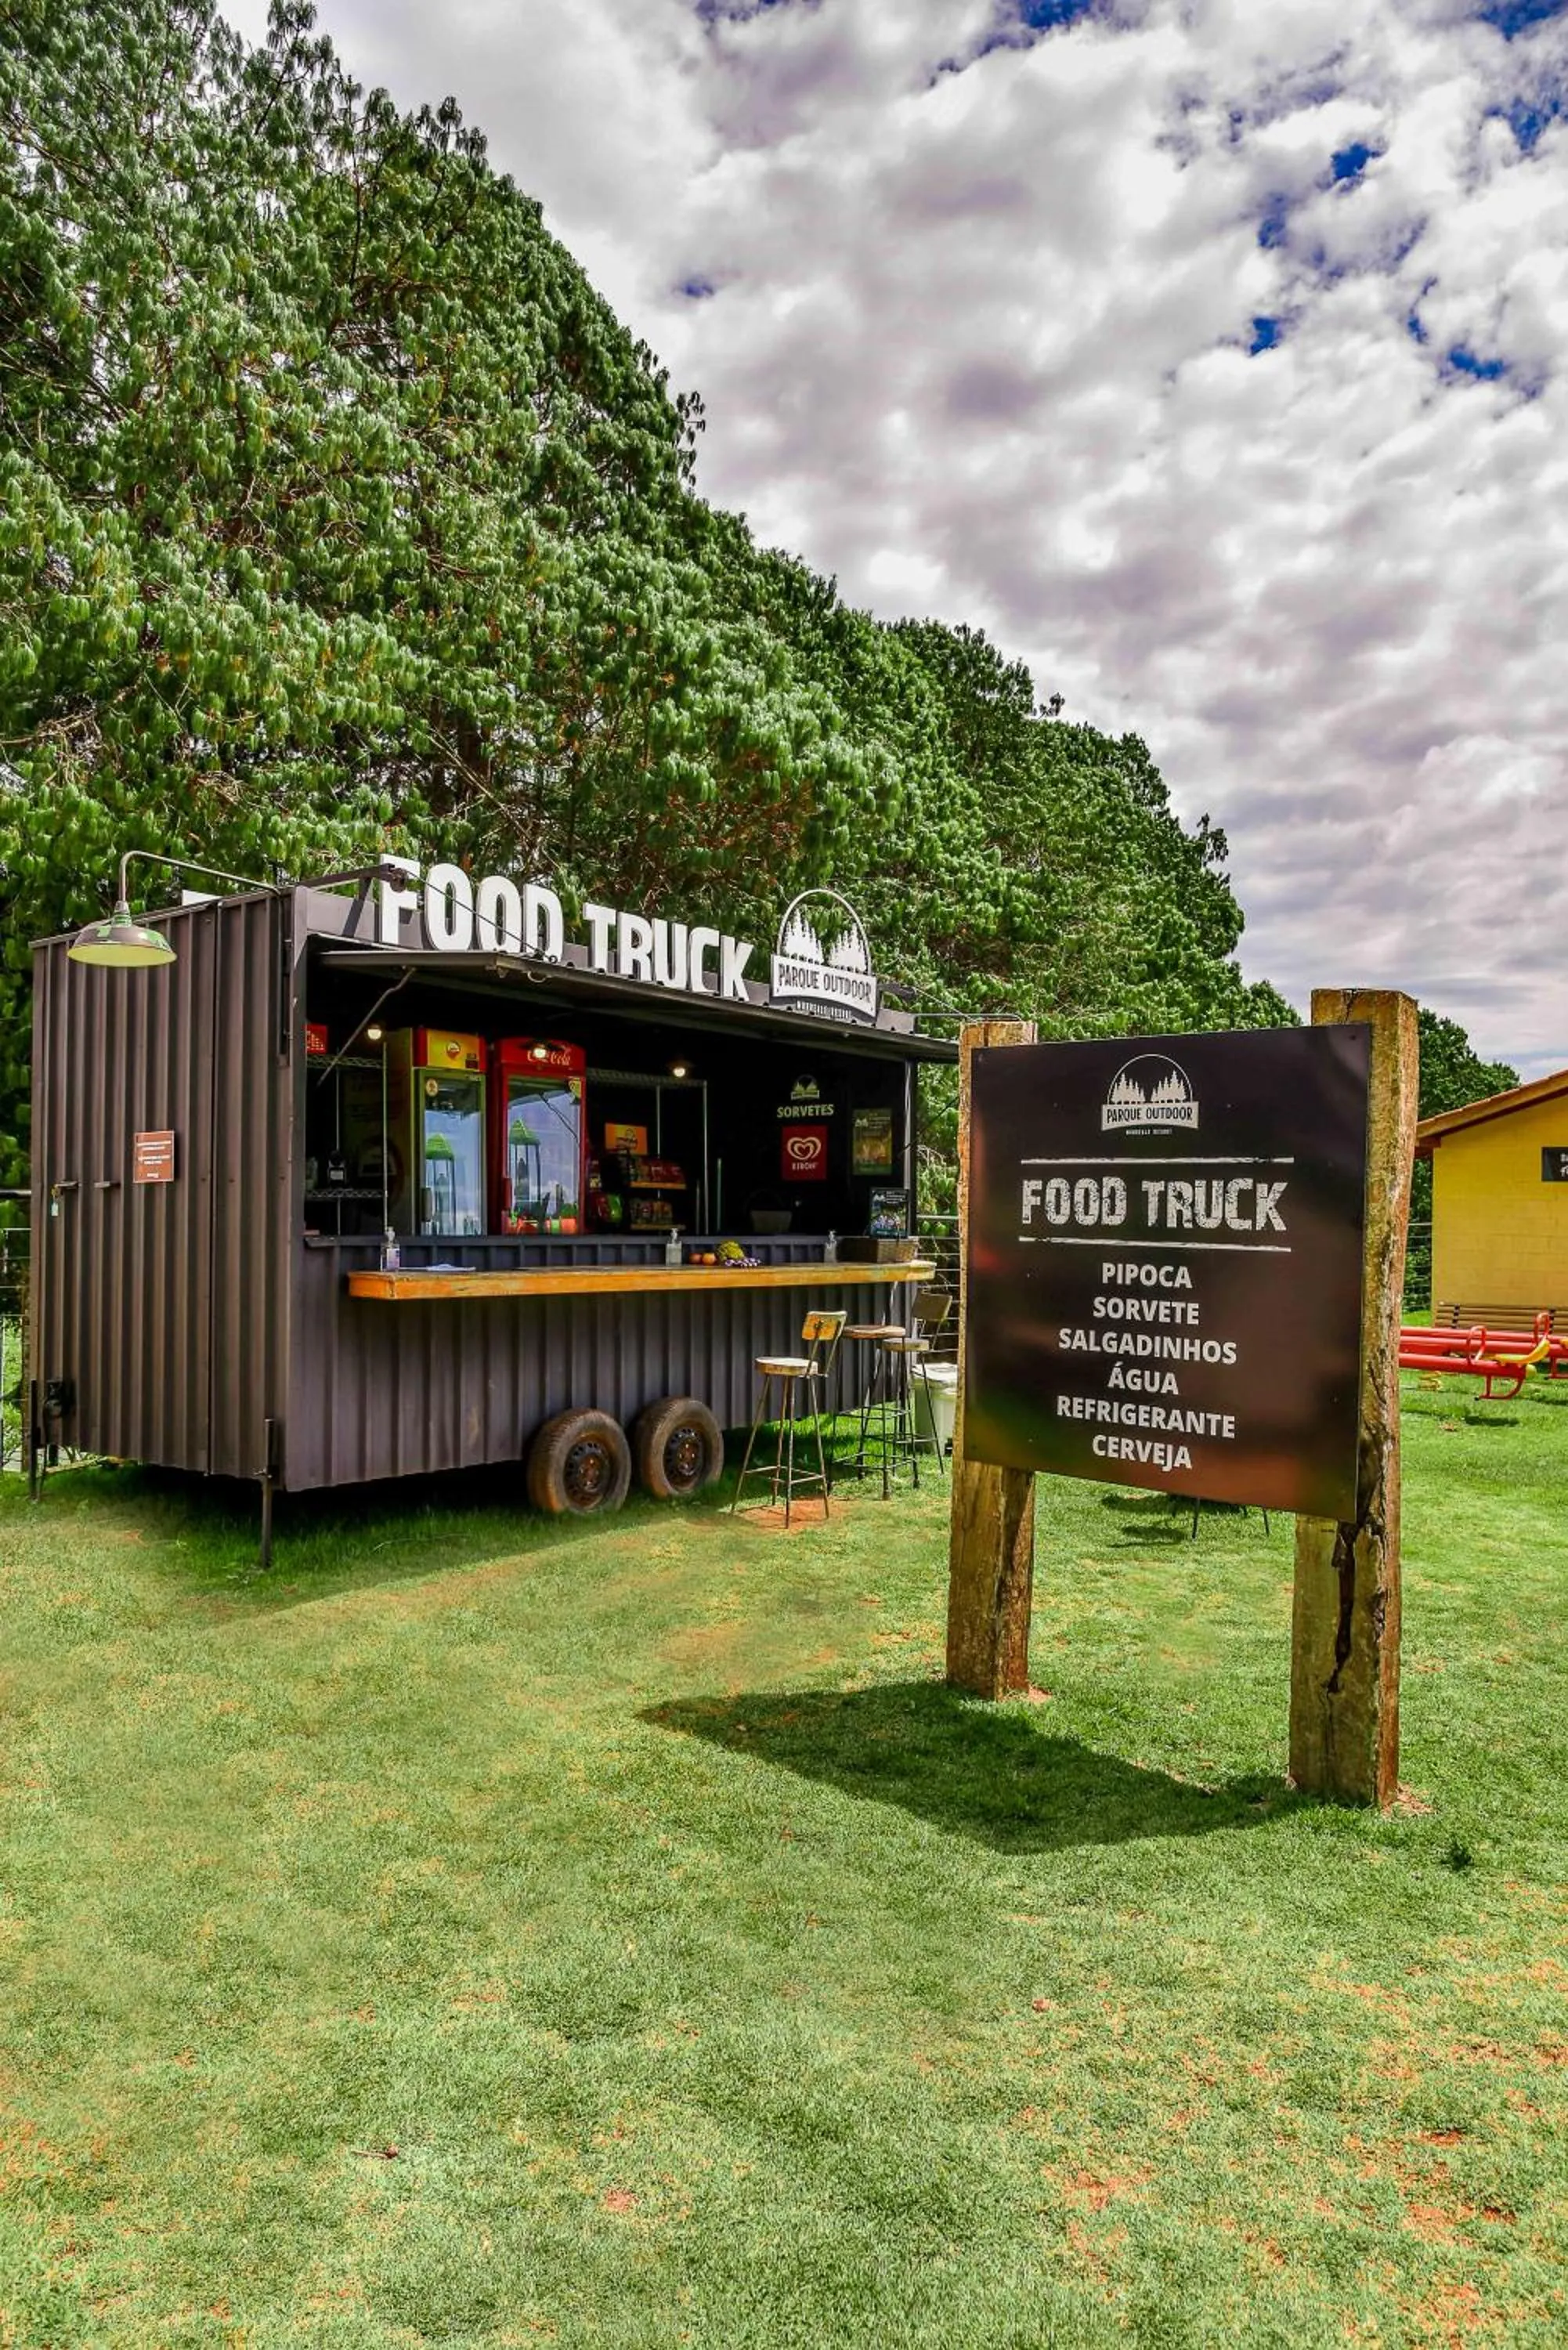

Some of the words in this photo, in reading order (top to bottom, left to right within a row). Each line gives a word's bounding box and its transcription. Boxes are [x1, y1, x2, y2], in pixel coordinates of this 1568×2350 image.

[379, 854, 563, 963] FOOD
[582, 902, 755, 1002] TRUCK
[778, 963, 820, 989] PARQUE
[823, 974, 872, 1003] OUTDOOR
[776, 1104, 835, 1119] SORVETES
[1107, 1108, 1142, 1123] PARQUE
[1146, 1107, 1193, 1121] OUTDOOR
[1021, 1176, 1128, 1226] FOOD
[1141, 1177, 1288, 1231] TRUCK
[1101, 1262, 1193, 1289] PIPOCA
[1092, 1296, 1200, 1325] SORVETE
[1058, 1328, 1237, 1365] SALGADINHOS
[1107, 1361, 1180, 1395] ÁGUA
[1057, 1395, 1236, 1439] REFRIGERANTE
[1092, 1434, 1193, 1472] CERVEJA
